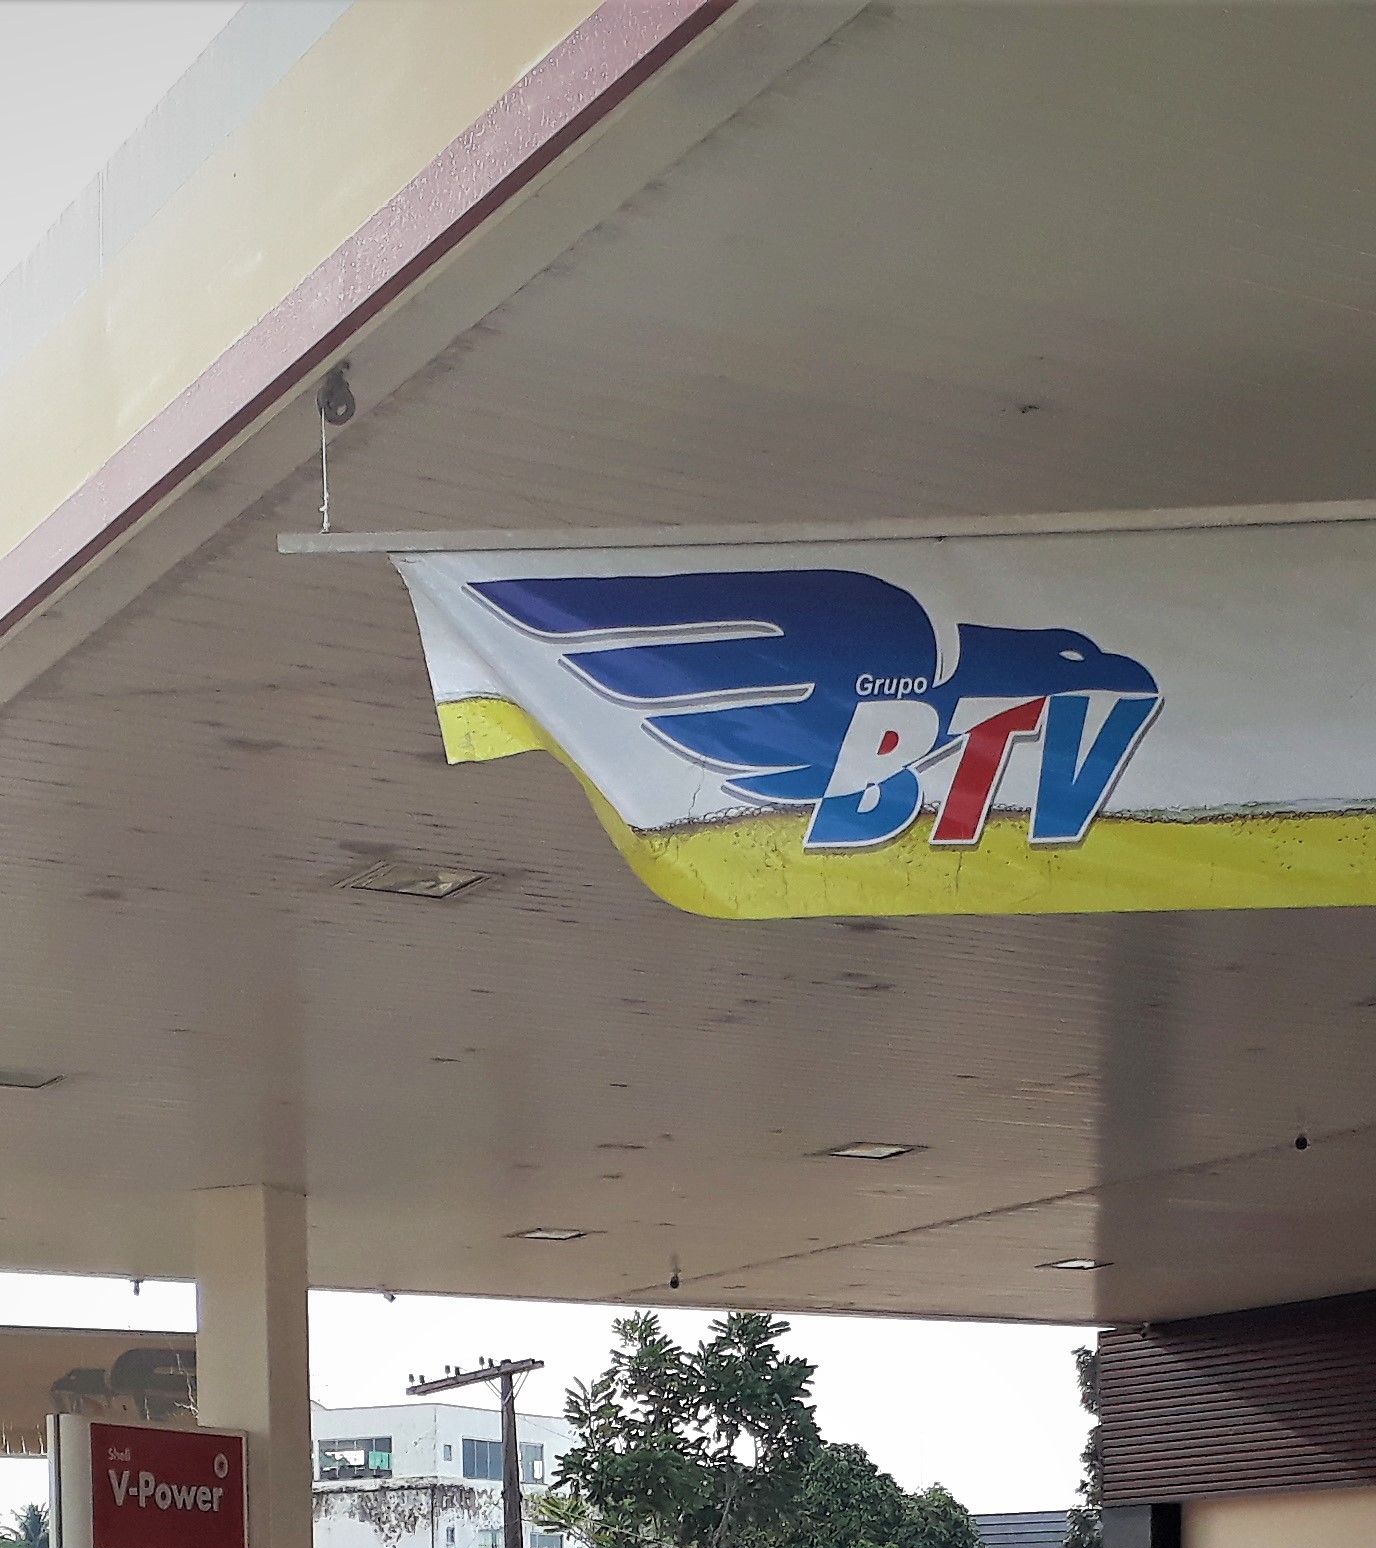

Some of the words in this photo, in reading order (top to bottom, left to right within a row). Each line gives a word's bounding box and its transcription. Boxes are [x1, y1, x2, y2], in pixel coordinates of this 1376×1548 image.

[856, 673, 927, 700] Grupo
[804, 695, 1164, 851] BTV
[108, 1470, 223, 1512] V-Power
